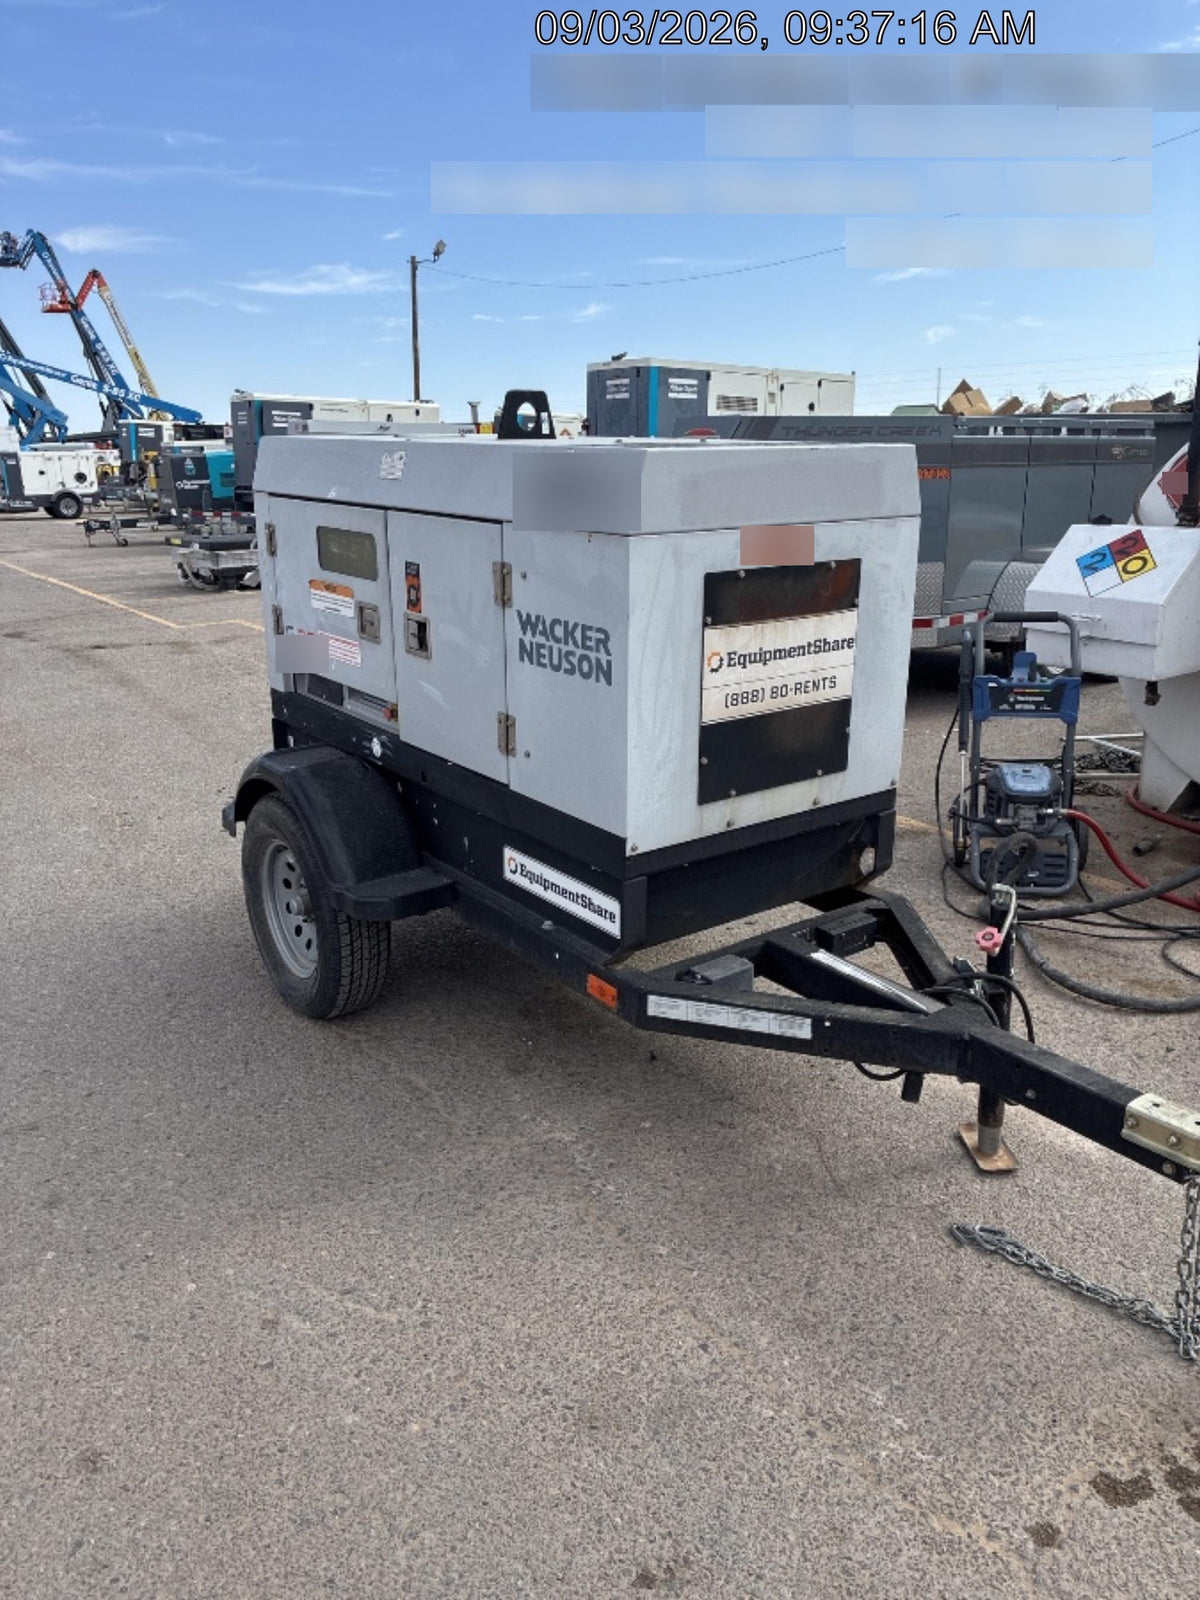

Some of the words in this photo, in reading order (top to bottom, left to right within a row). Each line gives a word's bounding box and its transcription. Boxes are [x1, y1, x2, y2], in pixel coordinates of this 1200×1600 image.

[782, 425, 873, 438] THUNDER
[876, 424, 943, 437] CREEK
[1082, 552, 1107, 571] 2
[1113, 536, 1139, 555] 2
[1121, 555, 1149, 575] 0
[516, 609, 612, 656] WACKER
[518, 638, 612, 687] NEUSON
[726, 637, 855, 669] EquipmentShare
[724, 687, 765, 709] (888)
[769, 675, 837, 699] 80-RENTS
[518, 863, 616, 924] EquipmentShare
